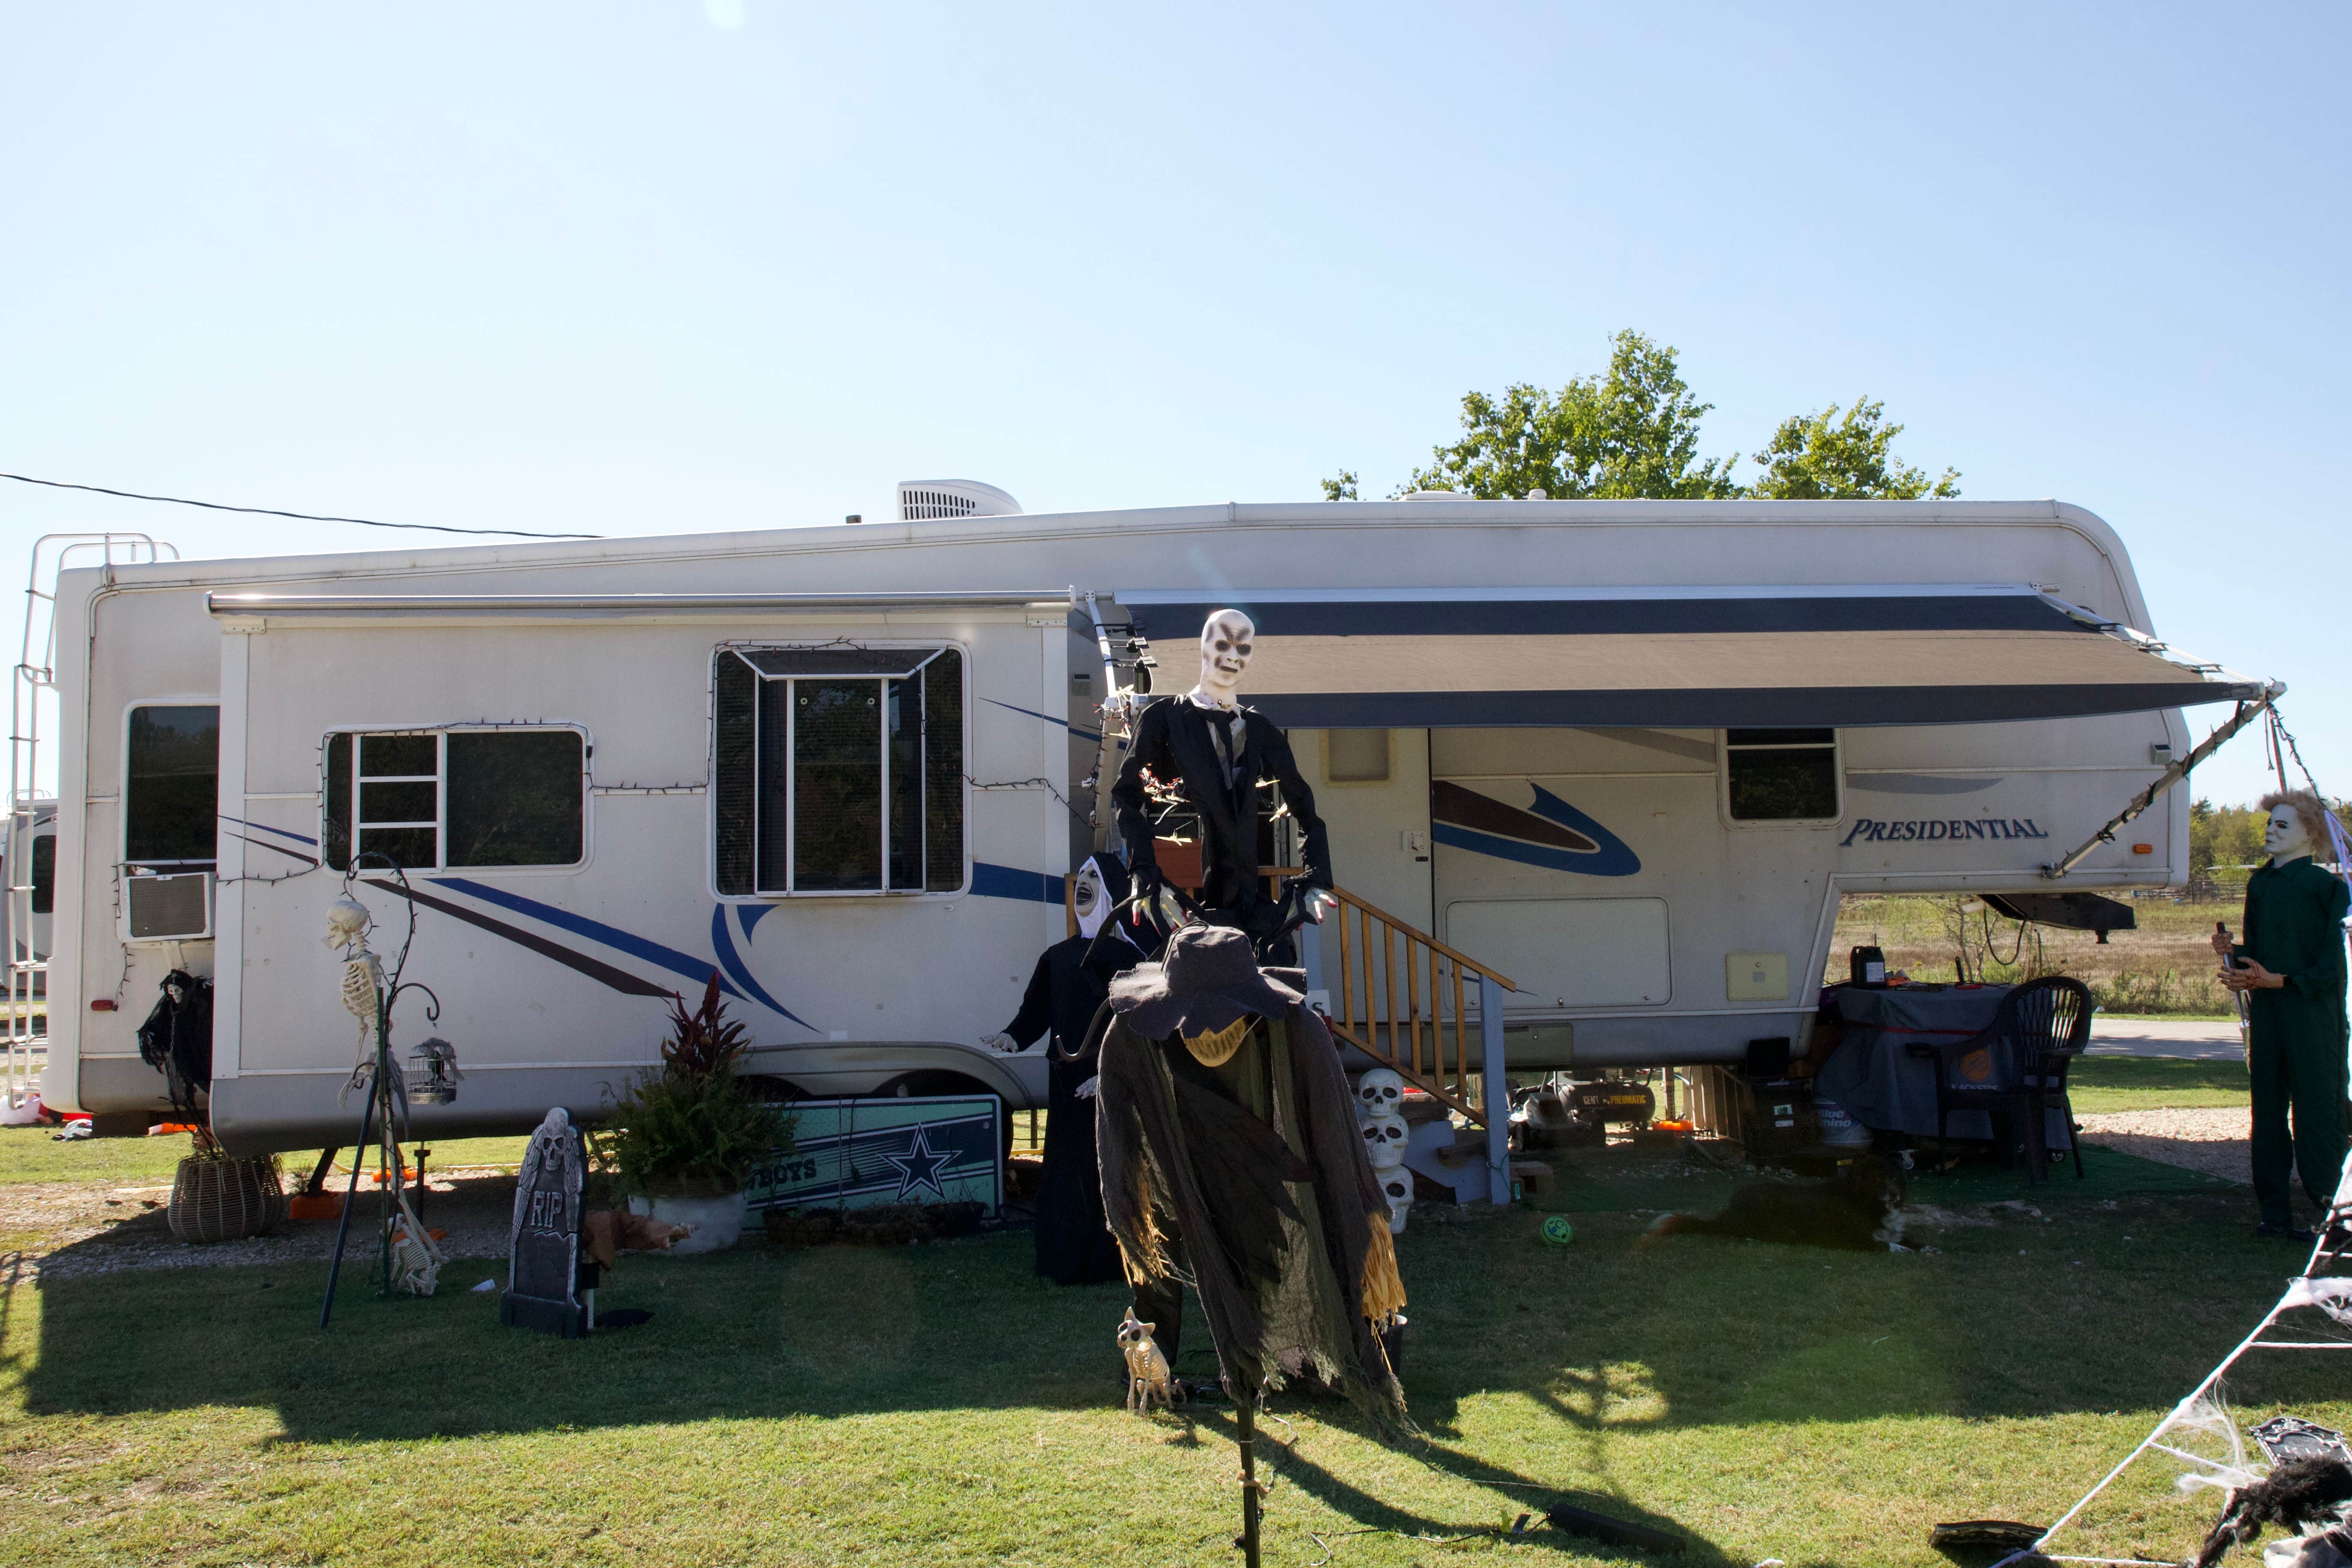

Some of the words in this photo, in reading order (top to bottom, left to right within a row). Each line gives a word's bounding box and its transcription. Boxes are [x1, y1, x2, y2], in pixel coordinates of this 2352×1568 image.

[1839, 819, 2049, 847] PRESIDENTIAL
[1610, 1095, 1646, 1105] PNEUMATIC
[531, 1191, 563, 1228] RIP
